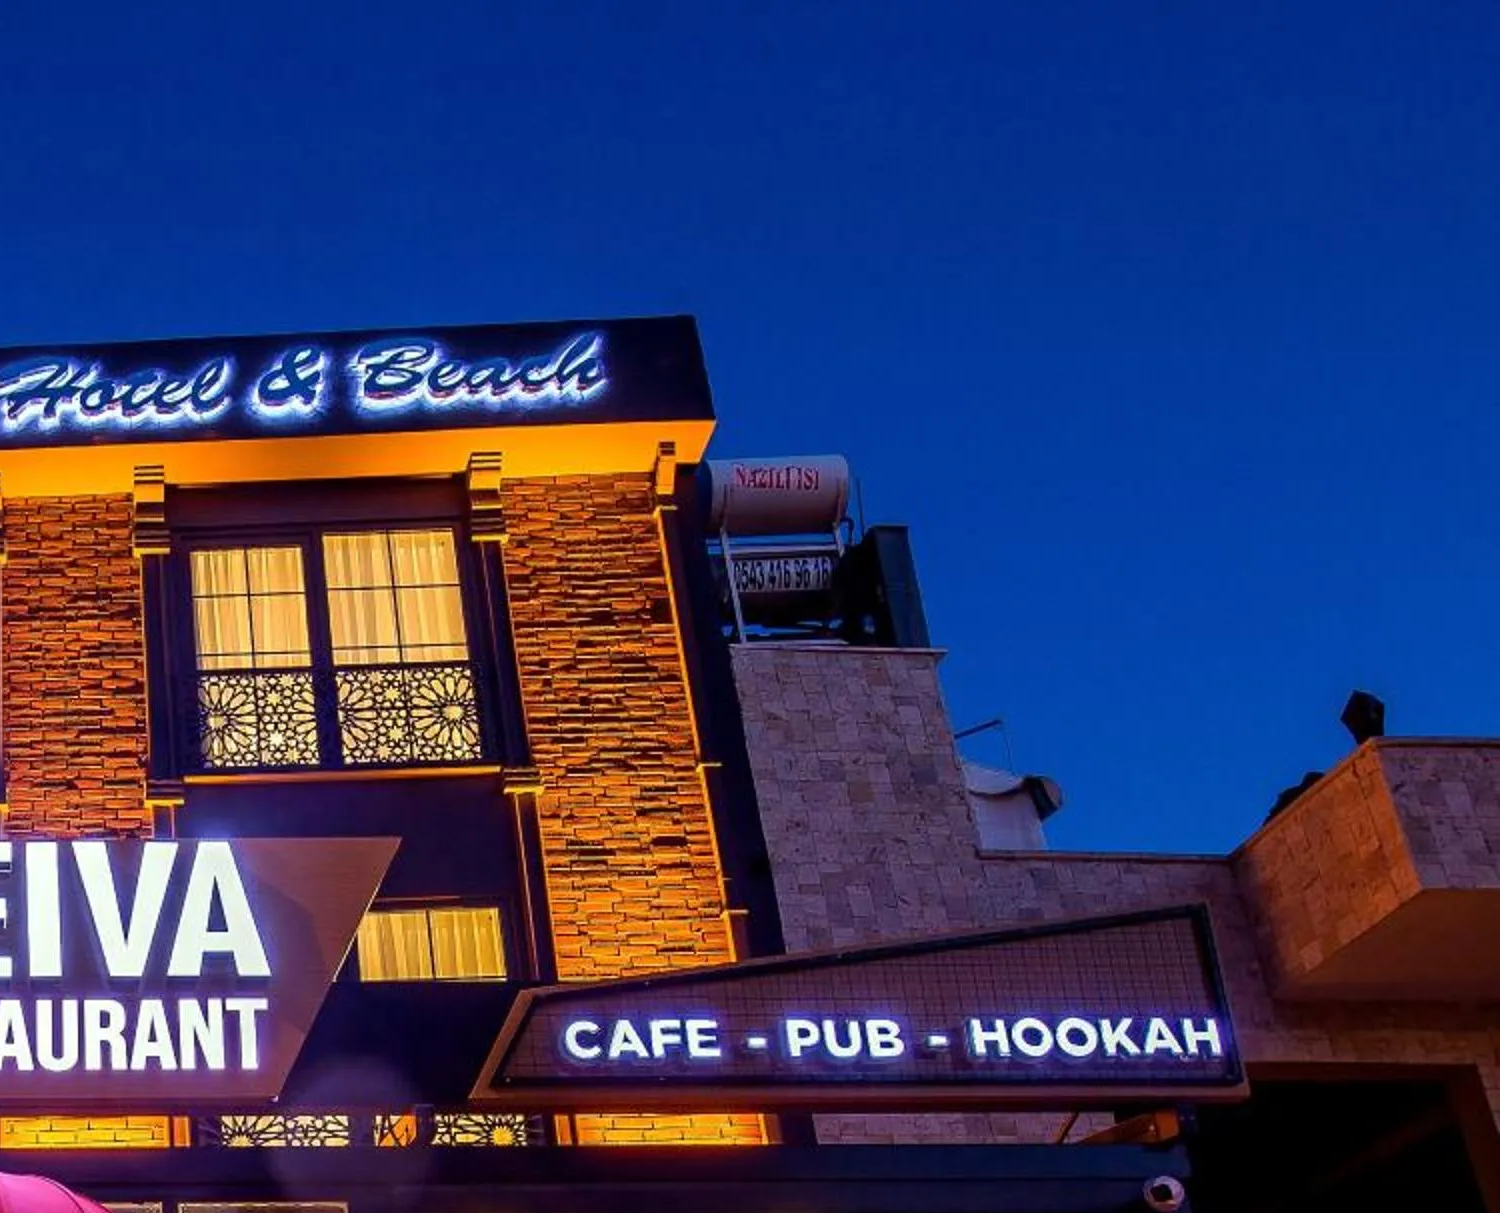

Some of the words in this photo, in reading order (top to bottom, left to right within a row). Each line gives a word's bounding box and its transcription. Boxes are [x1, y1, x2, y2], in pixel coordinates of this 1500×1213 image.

[253, 346, 323, 414] &
[356, 330, 606, 404] Beach
[564, 1019, 721, 1059] CAFE
[786, 1018, 905, 1058] PUB
[970, 1017, 1223, 1058] HOOKAH
